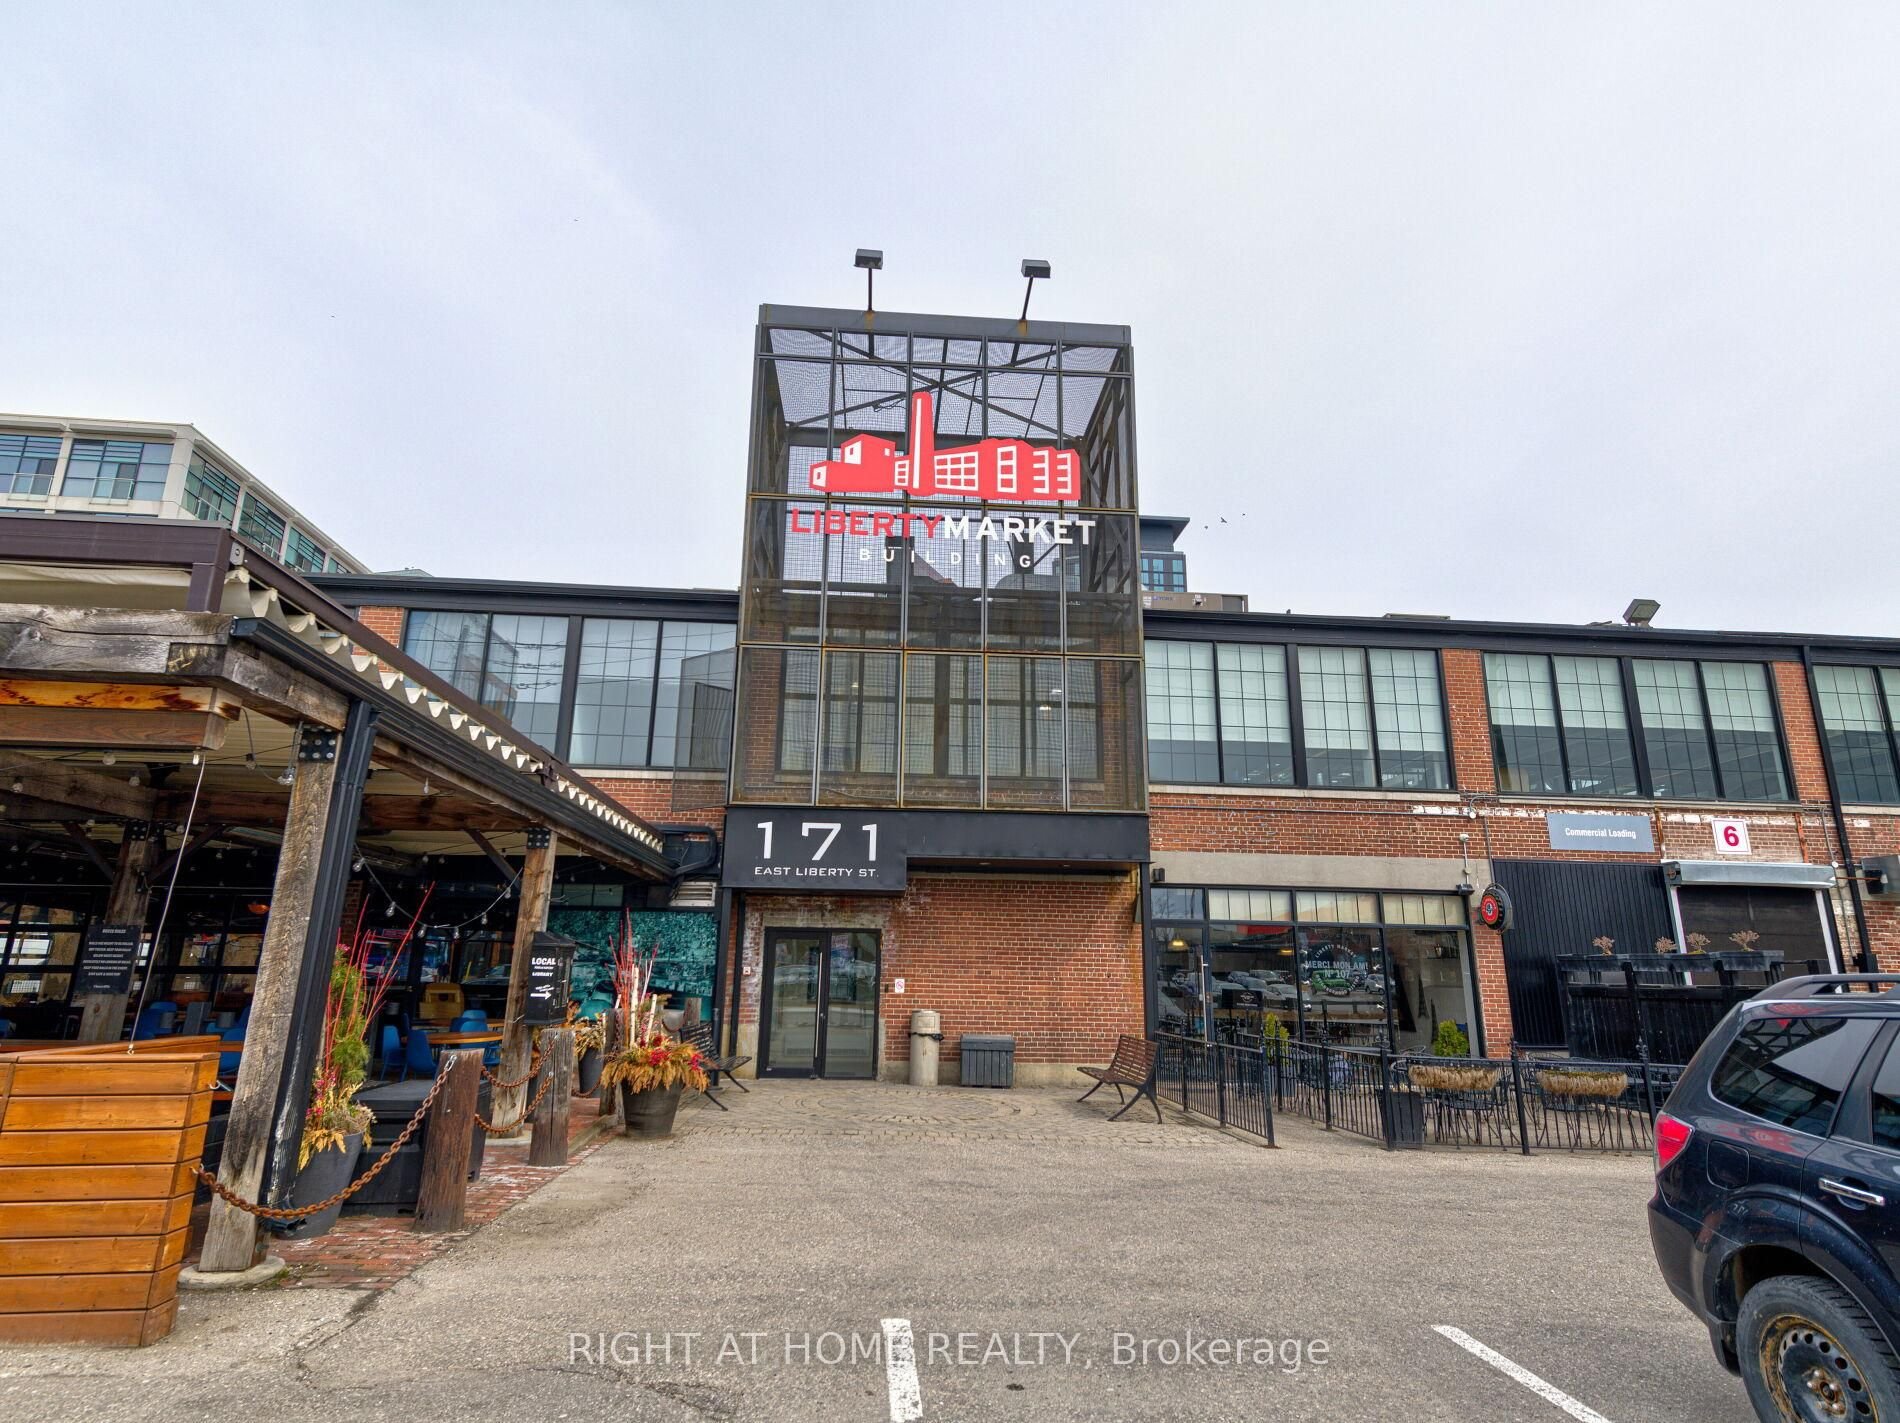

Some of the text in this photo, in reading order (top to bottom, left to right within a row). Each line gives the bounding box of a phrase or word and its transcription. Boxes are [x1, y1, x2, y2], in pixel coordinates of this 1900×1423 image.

[859, 547, 1032, 568] BUILDING
[1565, 827, 1637, 839] Commercial Loading
[1723, 825, 1740, 847] 6
[757, 821, 878, 862] 171
[754, 866, 879, 878] EAST LIBERTY ST.
[1315, 944, 1334, 958] LIBERTY
[531, 957, 556, 966] LOCAL
[1305, 960, 1330, 969] MERCI
[1333, 960, 1351, 969] MON
